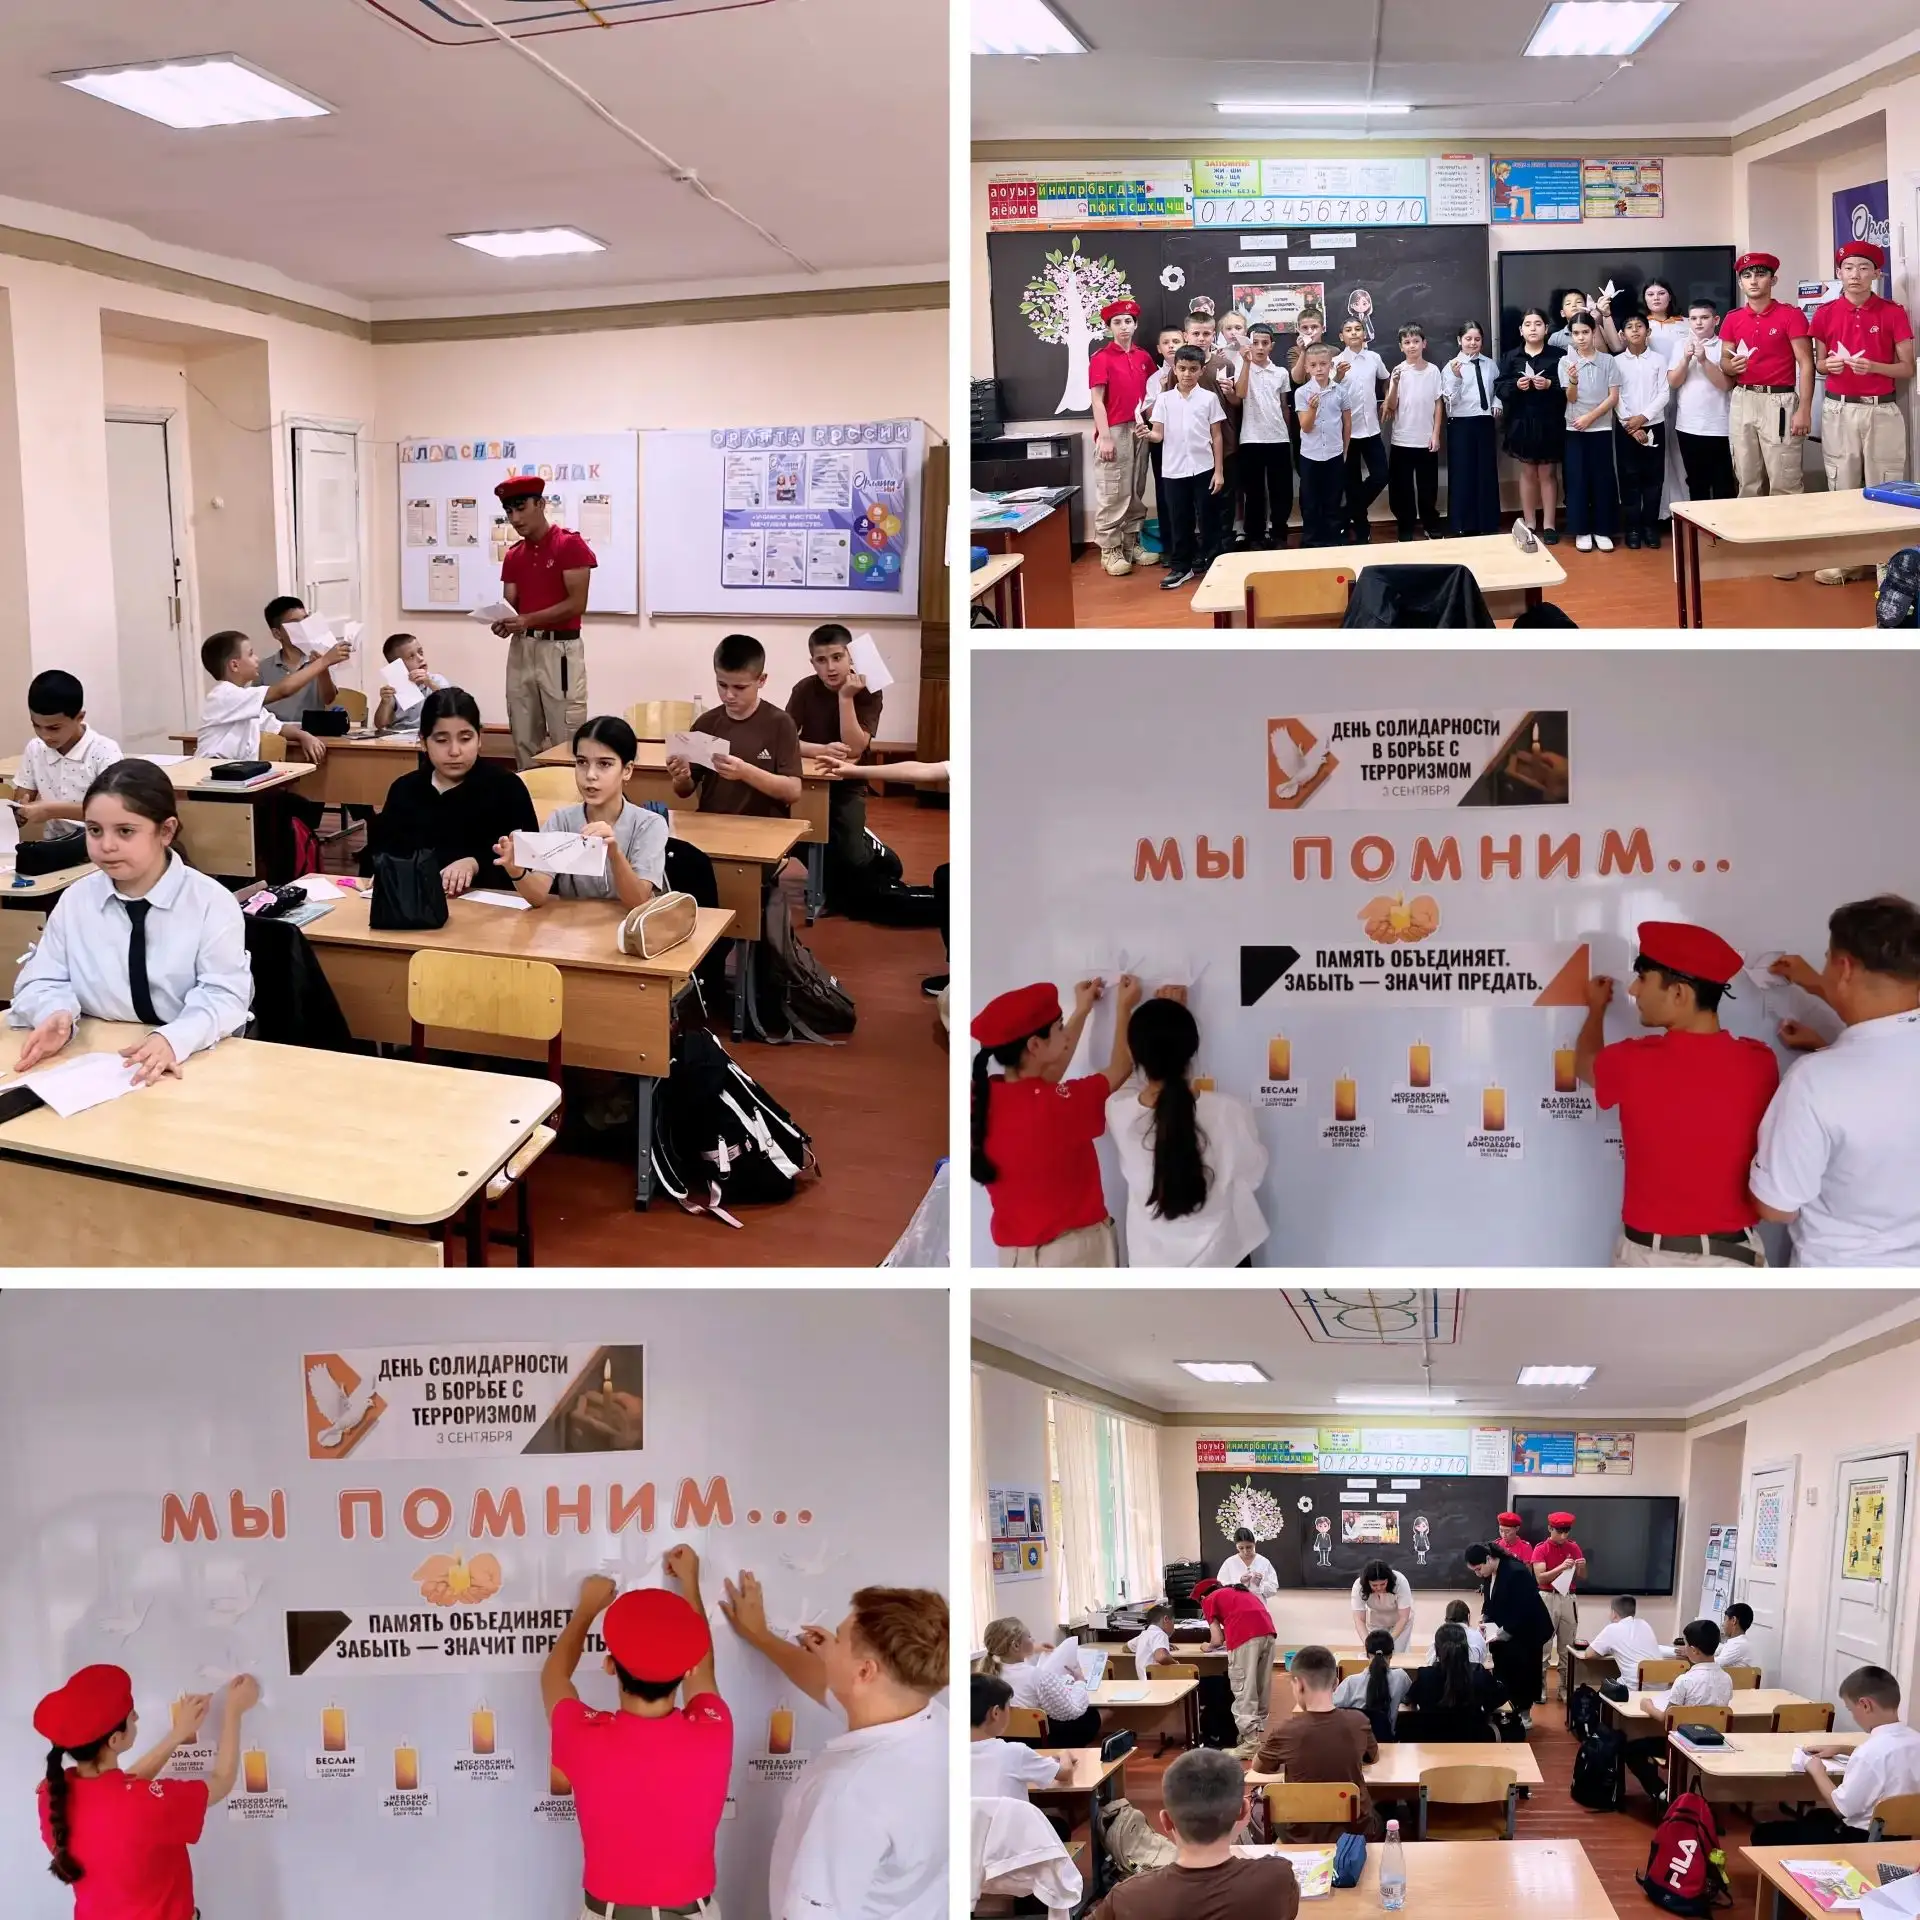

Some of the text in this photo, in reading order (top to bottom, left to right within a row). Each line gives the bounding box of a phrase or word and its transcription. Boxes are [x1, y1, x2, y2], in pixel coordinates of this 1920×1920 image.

[1332, 718, 1500, 741] ДЕНЬ СОЛИДАРНОСТИ
[1372, 740, 1460, 758] В БОРЬБЕ С
[1360, 763, 1472, 781] ТЕРРОРИЗМОМ
[1382, 784, 1450, 797] 3 СЕНТЯБРЯ
[1134, 828, 1730, 882] МЫ ПОМНИМ...
[1316, 949, 1510, 970] ПАМЯТЬ ОБЪЕДИНЯЕТ.
[1284, 972, 1354, 992] ЗАБЫТЬ
[1384, 972, 1452, 992] ЗНАЧИТ
[1458, 972, 1544, 994] ПРЕДАТЬ.
[1260, 1086, 1298, 1094] БЕСЛАН
[378, 1355, 569, 1382] ДЕНЬ СОЛИДАРНОСТИ
[425, 1380, 524, 1401] В БОРЬБЕ С
[412, 1404, 537, 1428] ТЕРРОРИЗМОМ
[436, 1430, 513, 1444] 3 СЕНТЯБРЯ
[161, 1476, 813, 1543] МЫ ПОМНИМ...
[368, 1609, 574, 1634] ПАМЯТЬ ОБЪЕДИНЯЕТ
[336, 1636, 412, 1660] ЗАБЫТЬ
[444, 1636, 516, 1656] ЗНАЧИТ
[522, 1634, 606, 1654] ПРЕТЬ
[1669, 1840, 1698, 1888] FILA
